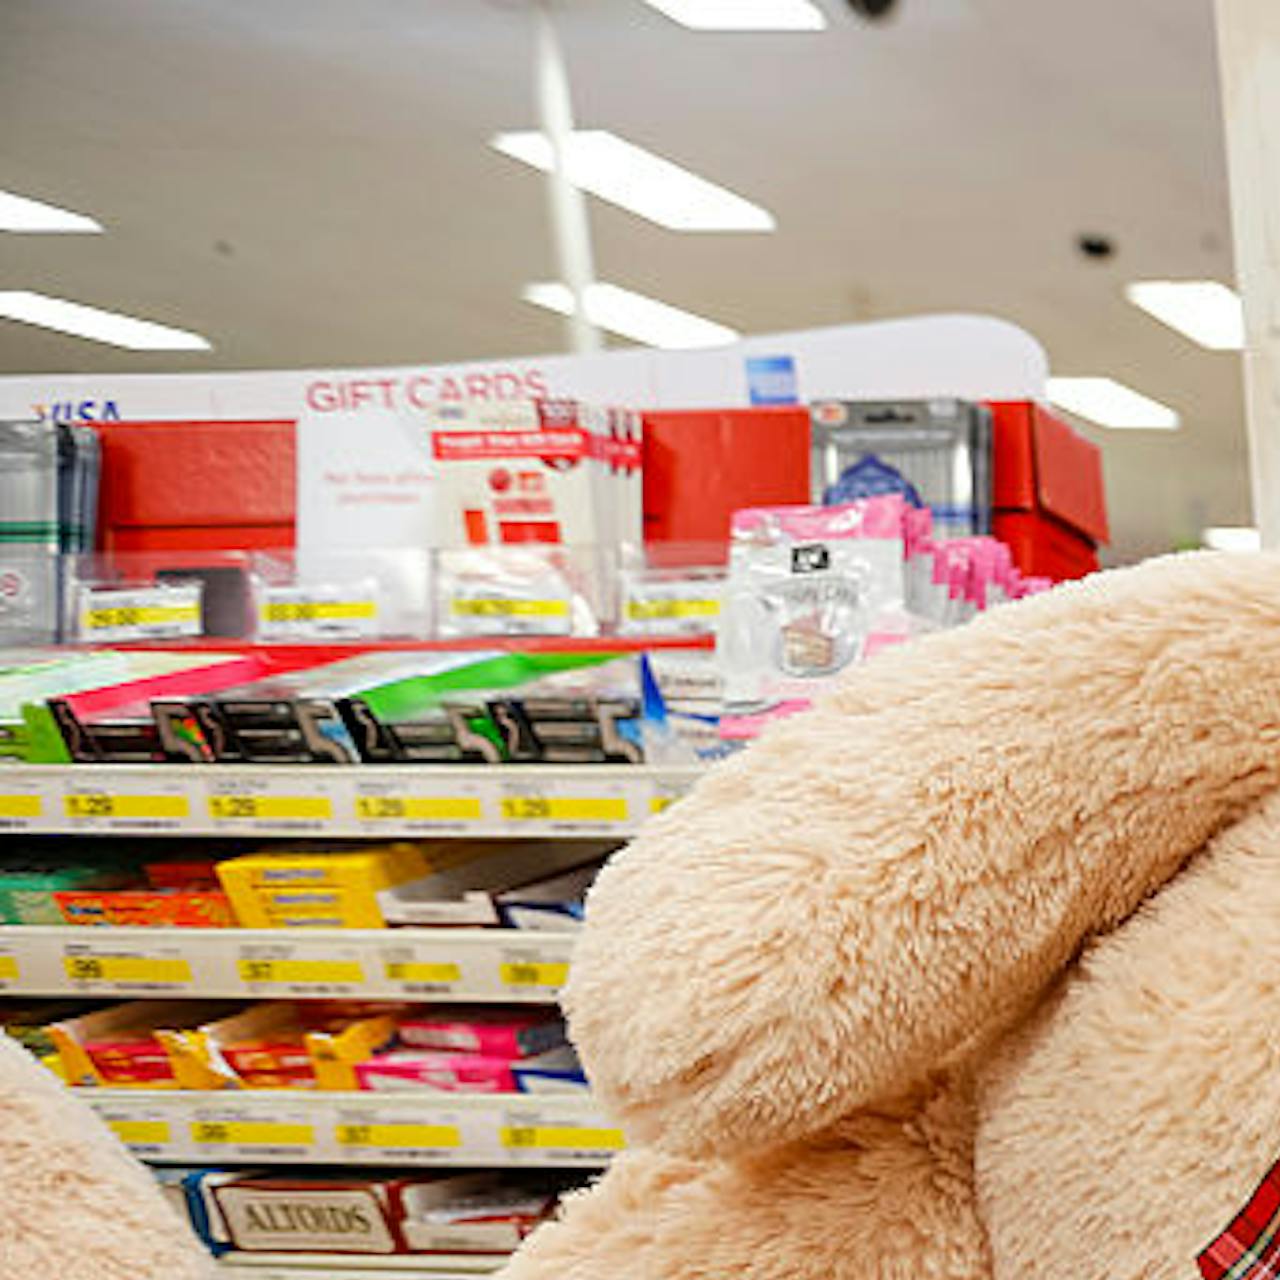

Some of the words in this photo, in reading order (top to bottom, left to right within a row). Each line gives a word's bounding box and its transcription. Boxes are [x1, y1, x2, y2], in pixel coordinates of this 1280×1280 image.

[306, 378, 398, 412] GIFT
[407, 369, 548, 408] CARDS
[245, 1204, 371, 1234] ALTOIDS
